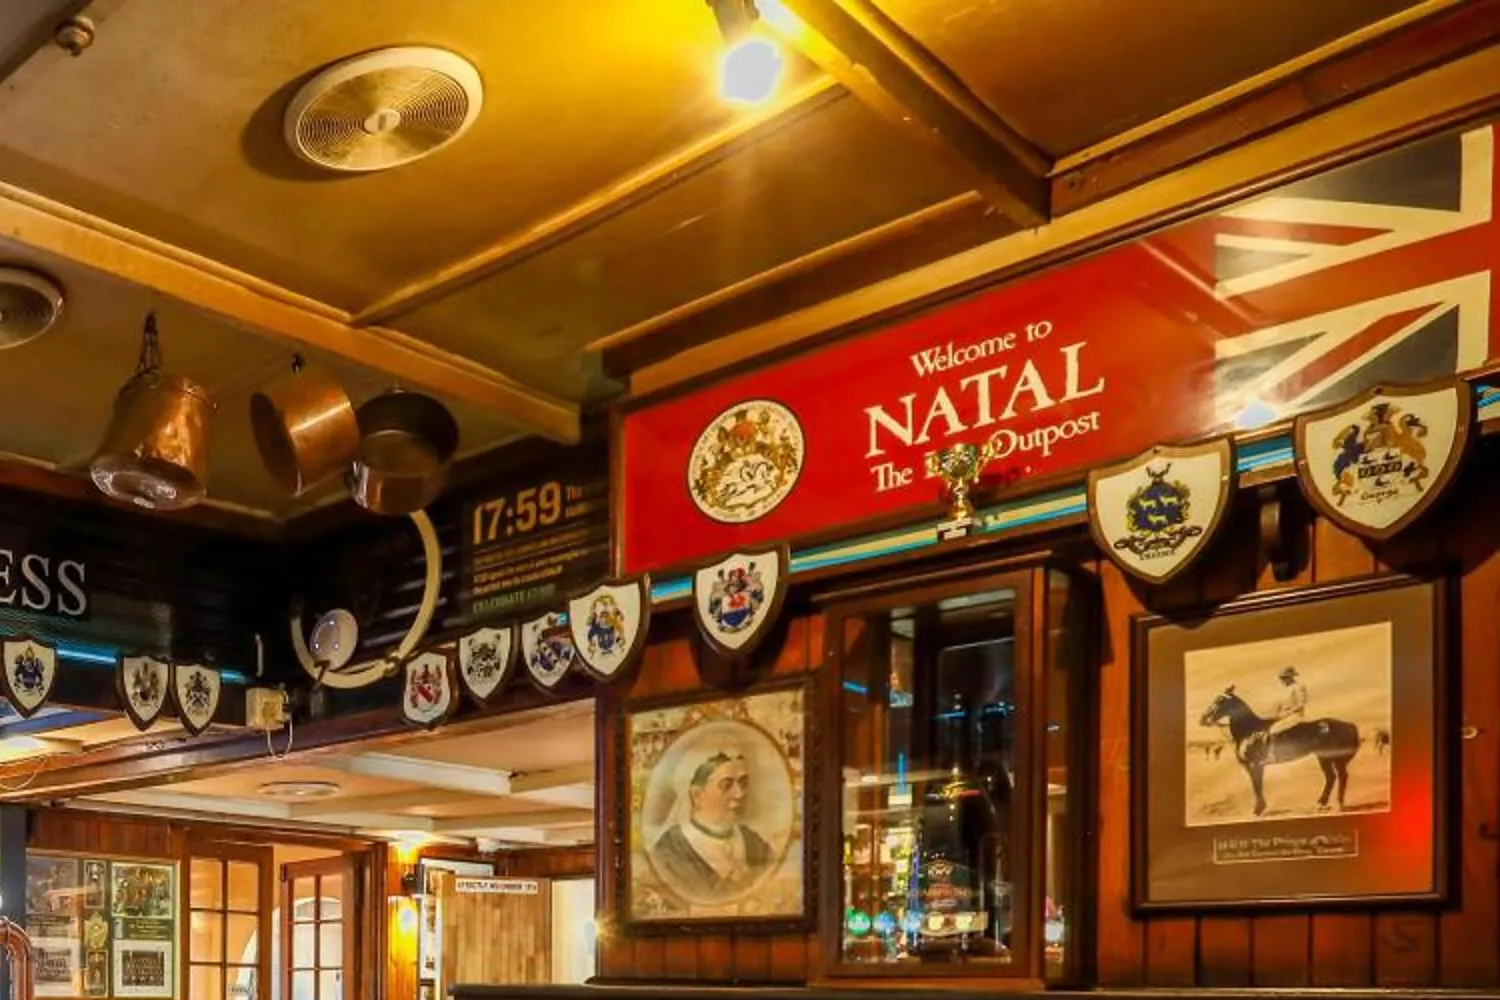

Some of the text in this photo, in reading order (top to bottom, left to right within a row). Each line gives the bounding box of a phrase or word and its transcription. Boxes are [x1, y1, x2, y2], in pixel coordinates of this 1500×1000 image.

[910, 319, 1053, 378] Welcome to
[863, 340, 1106, 458] NATAL
[870, 461, 913, 494] The
[992, 410, 1102, 461] Outpost
[473, 480, 562, 546] 17:59
